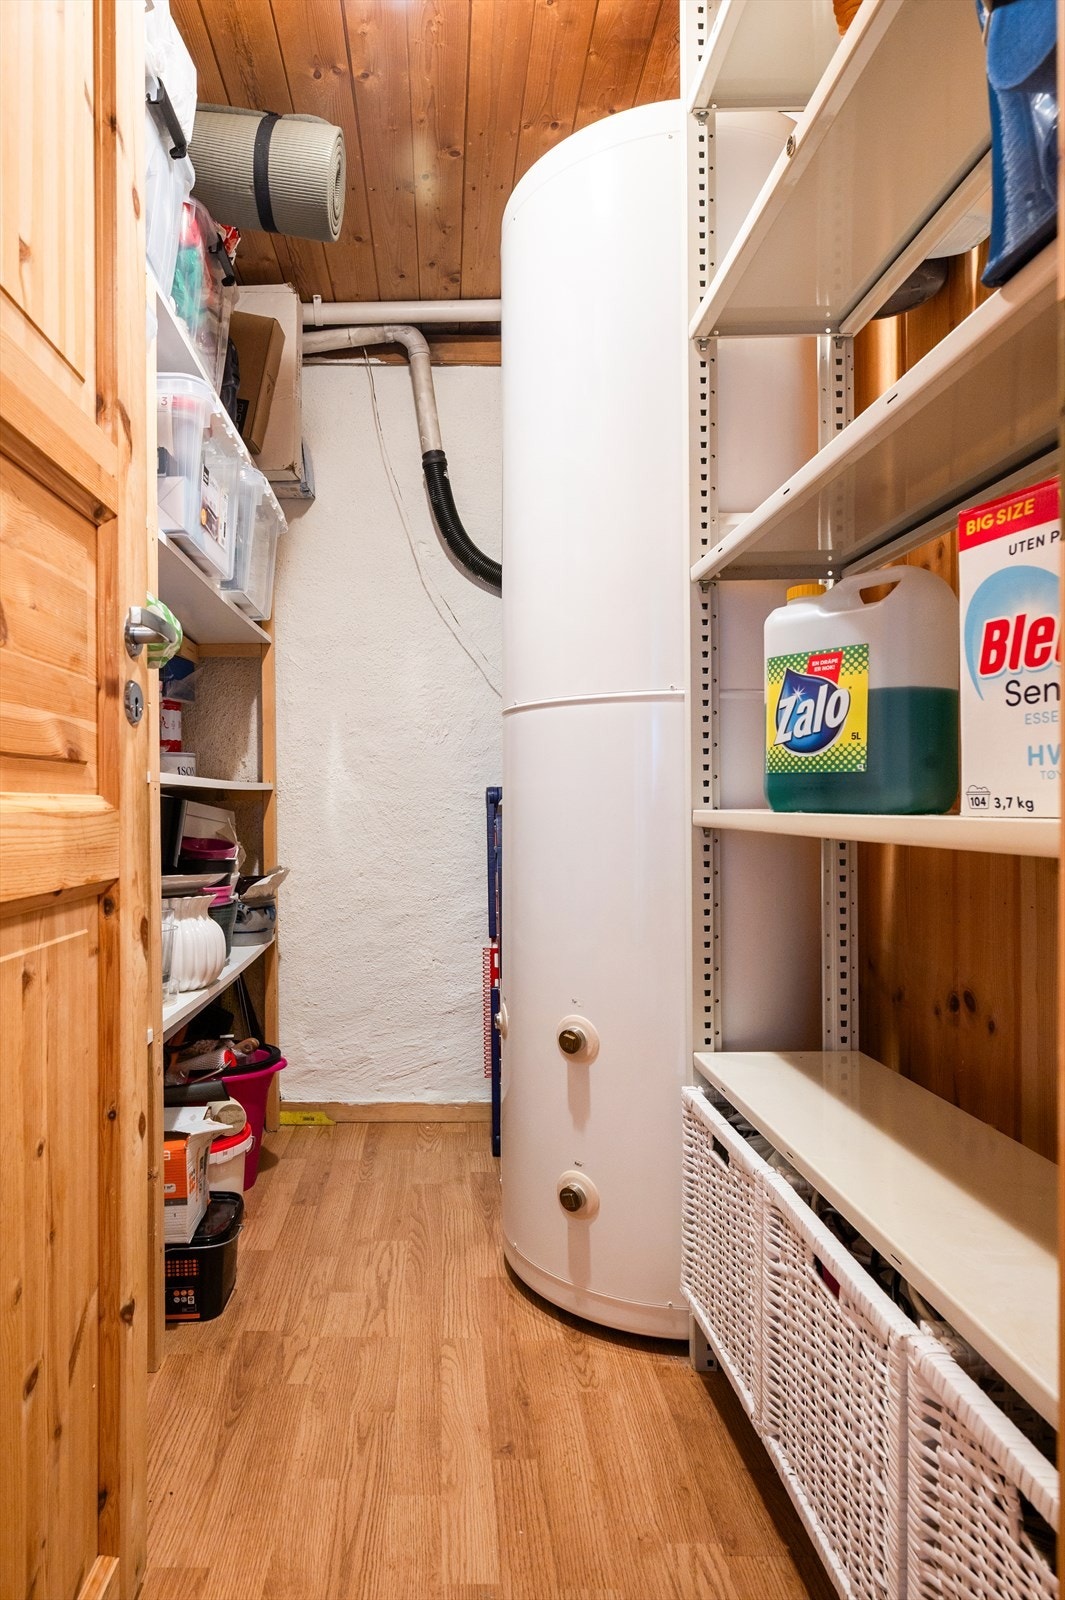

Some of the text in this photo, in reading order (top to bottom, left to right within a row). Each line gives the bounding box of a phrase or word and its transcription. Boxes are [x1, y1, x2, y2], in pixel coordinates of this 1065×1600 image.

[965, 497, 1036, 536] BIG SIZE
[1008, 530, 1062, 556] UTEN P
[979, 613, 1062, 676] Ble
[773, 683, 851, 746] Zalo
[851, 732, 861, 741] 5L
[970, 793, 987, 807] 104
[994, 795, 1035, 812] 3,7 kg
